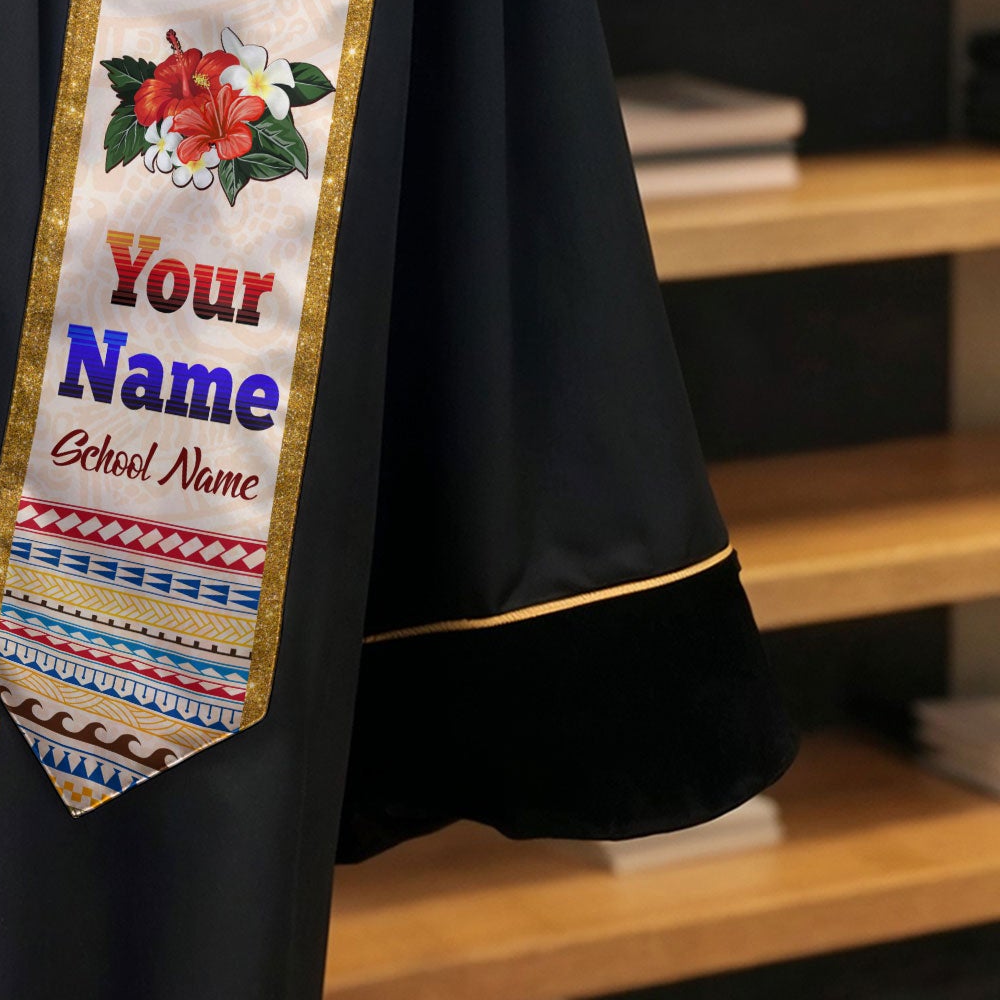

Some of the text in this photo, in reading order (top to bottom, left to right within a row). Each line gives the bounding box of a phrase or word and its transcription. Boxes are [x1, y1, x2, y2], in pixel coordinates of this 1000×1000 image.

[106, 229, 275, 327] Your
[57, 323, 280, 431] Name
[50, 428, 260, 501] School Name
